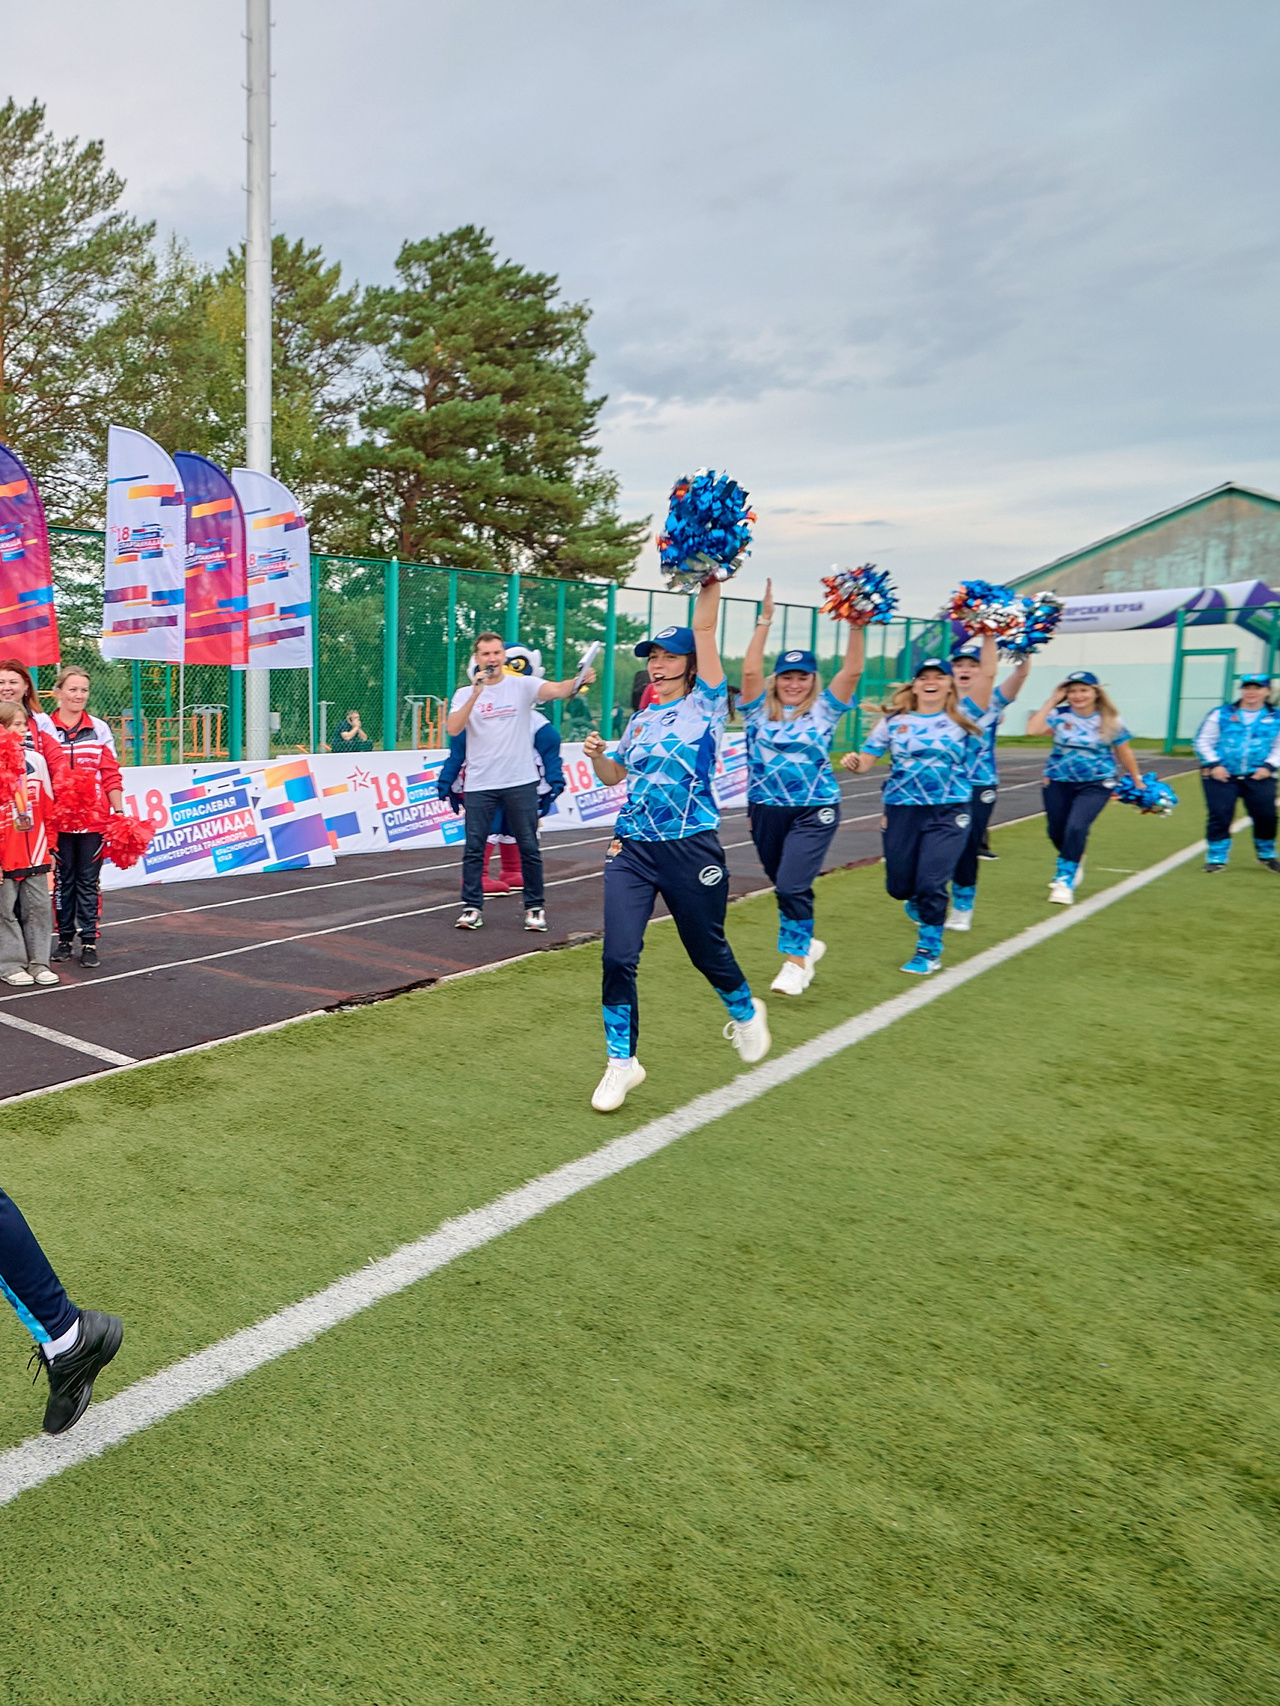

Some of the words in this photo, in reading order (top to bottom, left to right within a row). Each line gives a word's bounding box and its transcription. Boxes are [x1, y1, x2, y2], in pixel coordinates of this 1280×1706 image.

[117, 526, 130, 542] 18
[370, 771, 406, 811] 18
[408, 785, 439, 801] ОТРАС
[562, 760, 593, 794] 18
[124, 788, 168, 830] 18
[172, 796, 237, 823] ОТРАСЛЕВАЯ
[146, 810, 255, 855] СПАРТАКИАДА
[146, 843, 204, 867] МИНИСТЕРСТВА
[203, 832, 249, 851] ТРАНСПОРТА
